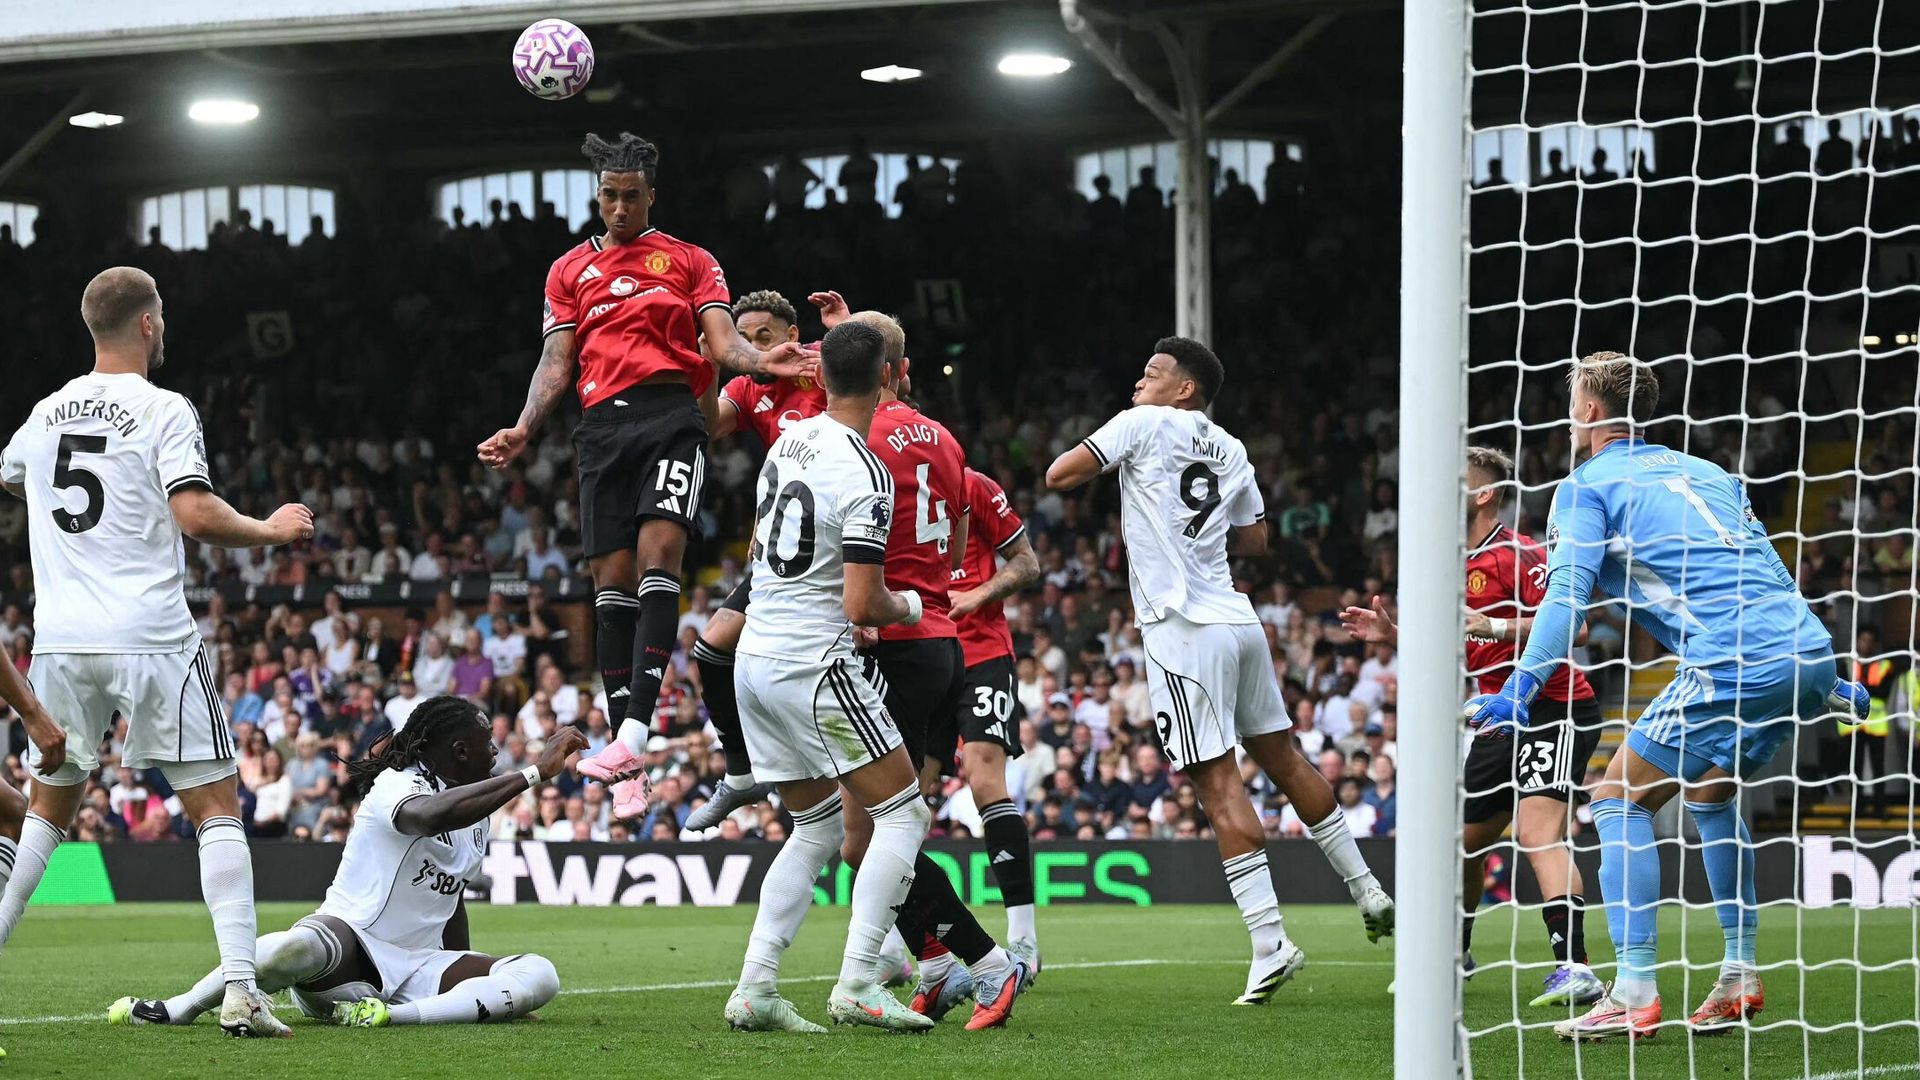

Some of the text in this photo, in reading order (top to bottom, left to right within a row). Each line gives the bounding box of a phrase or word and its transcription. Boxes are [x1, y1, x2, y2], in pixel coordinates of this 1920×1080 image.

[256, 317, 287, 352] G
[45, 399, 139, 438] ANDERSEN
[779, 439, 820, 470] LUKIĆ
[886, 423, 940, 454] DE LIGT
[51, 433, 107, 534] 5
[654, 459, 692, 496] 15
[753, 459, 816, 579] 20
[915, 463, 951, 555] 4
[1180, 462, 1222, 540] 9
[1663, 478, 1738, 548] 1
[972, 685, 1009, 723] 30
[1518, 740, 1555, 777] 23
[478, 839, 752, 907] tway
